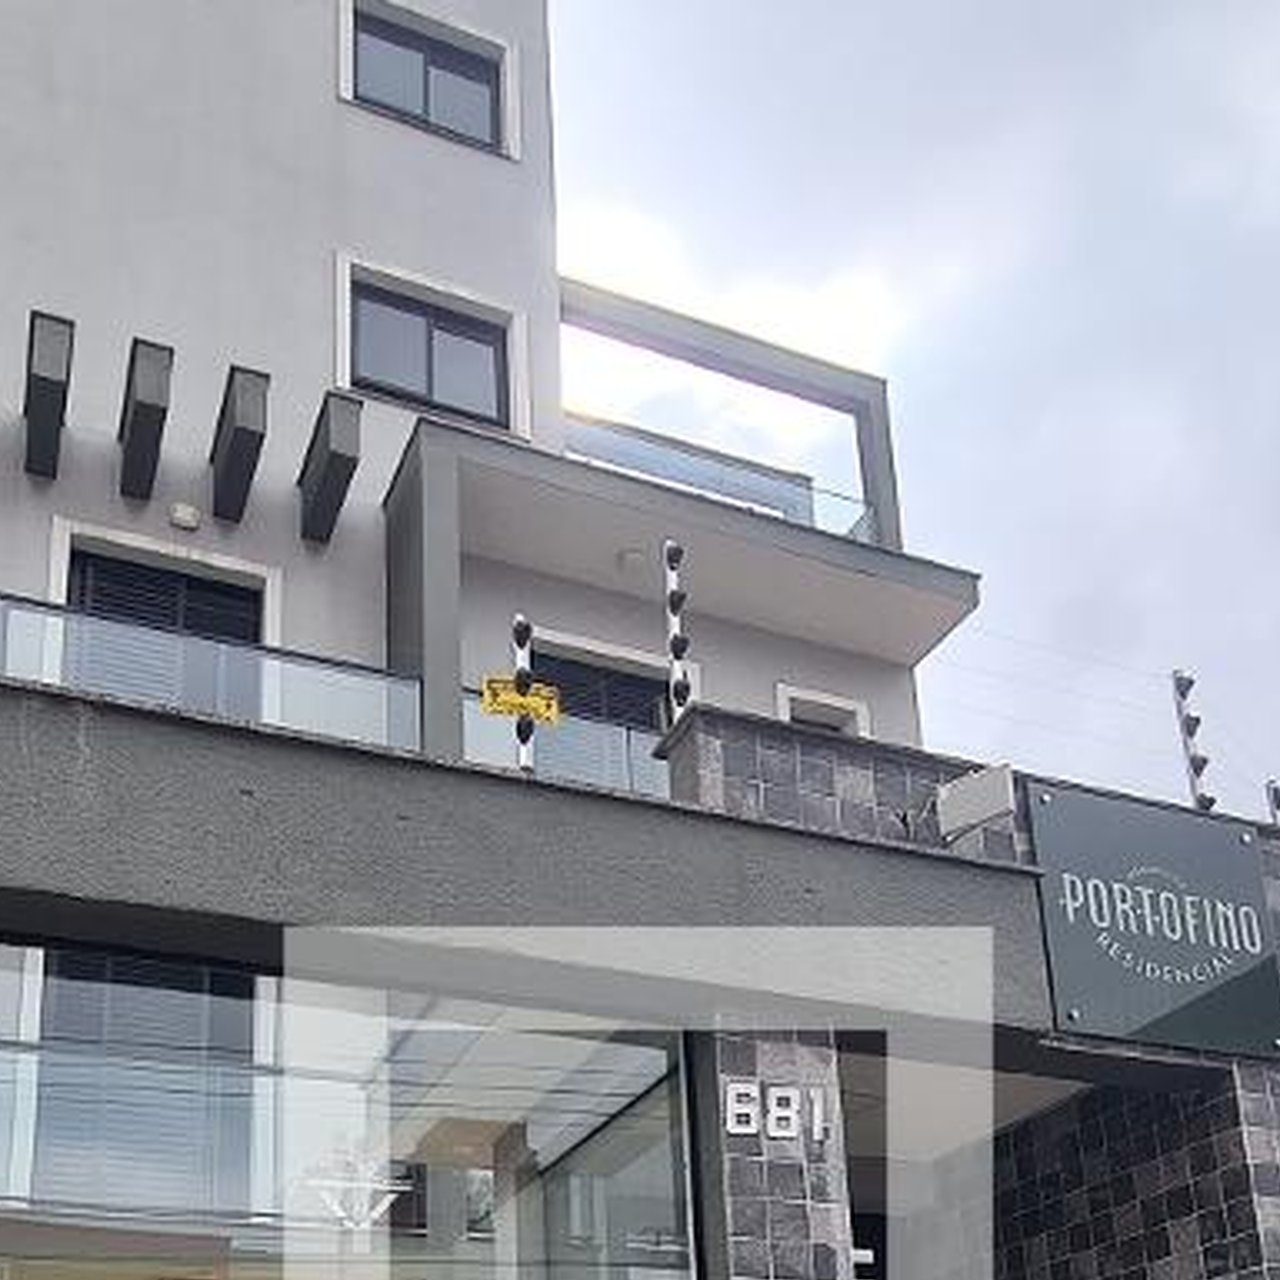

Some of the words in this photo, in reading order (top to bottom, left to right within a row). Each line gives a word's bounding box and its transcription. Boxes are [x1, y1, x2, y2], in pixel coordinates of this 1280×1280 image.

[1060, 872, 1262, 955] PORTOFINO
[1096, 932, 1233, 983] RESIDENCIAL
[725, 1082, 824, 1141] 681
